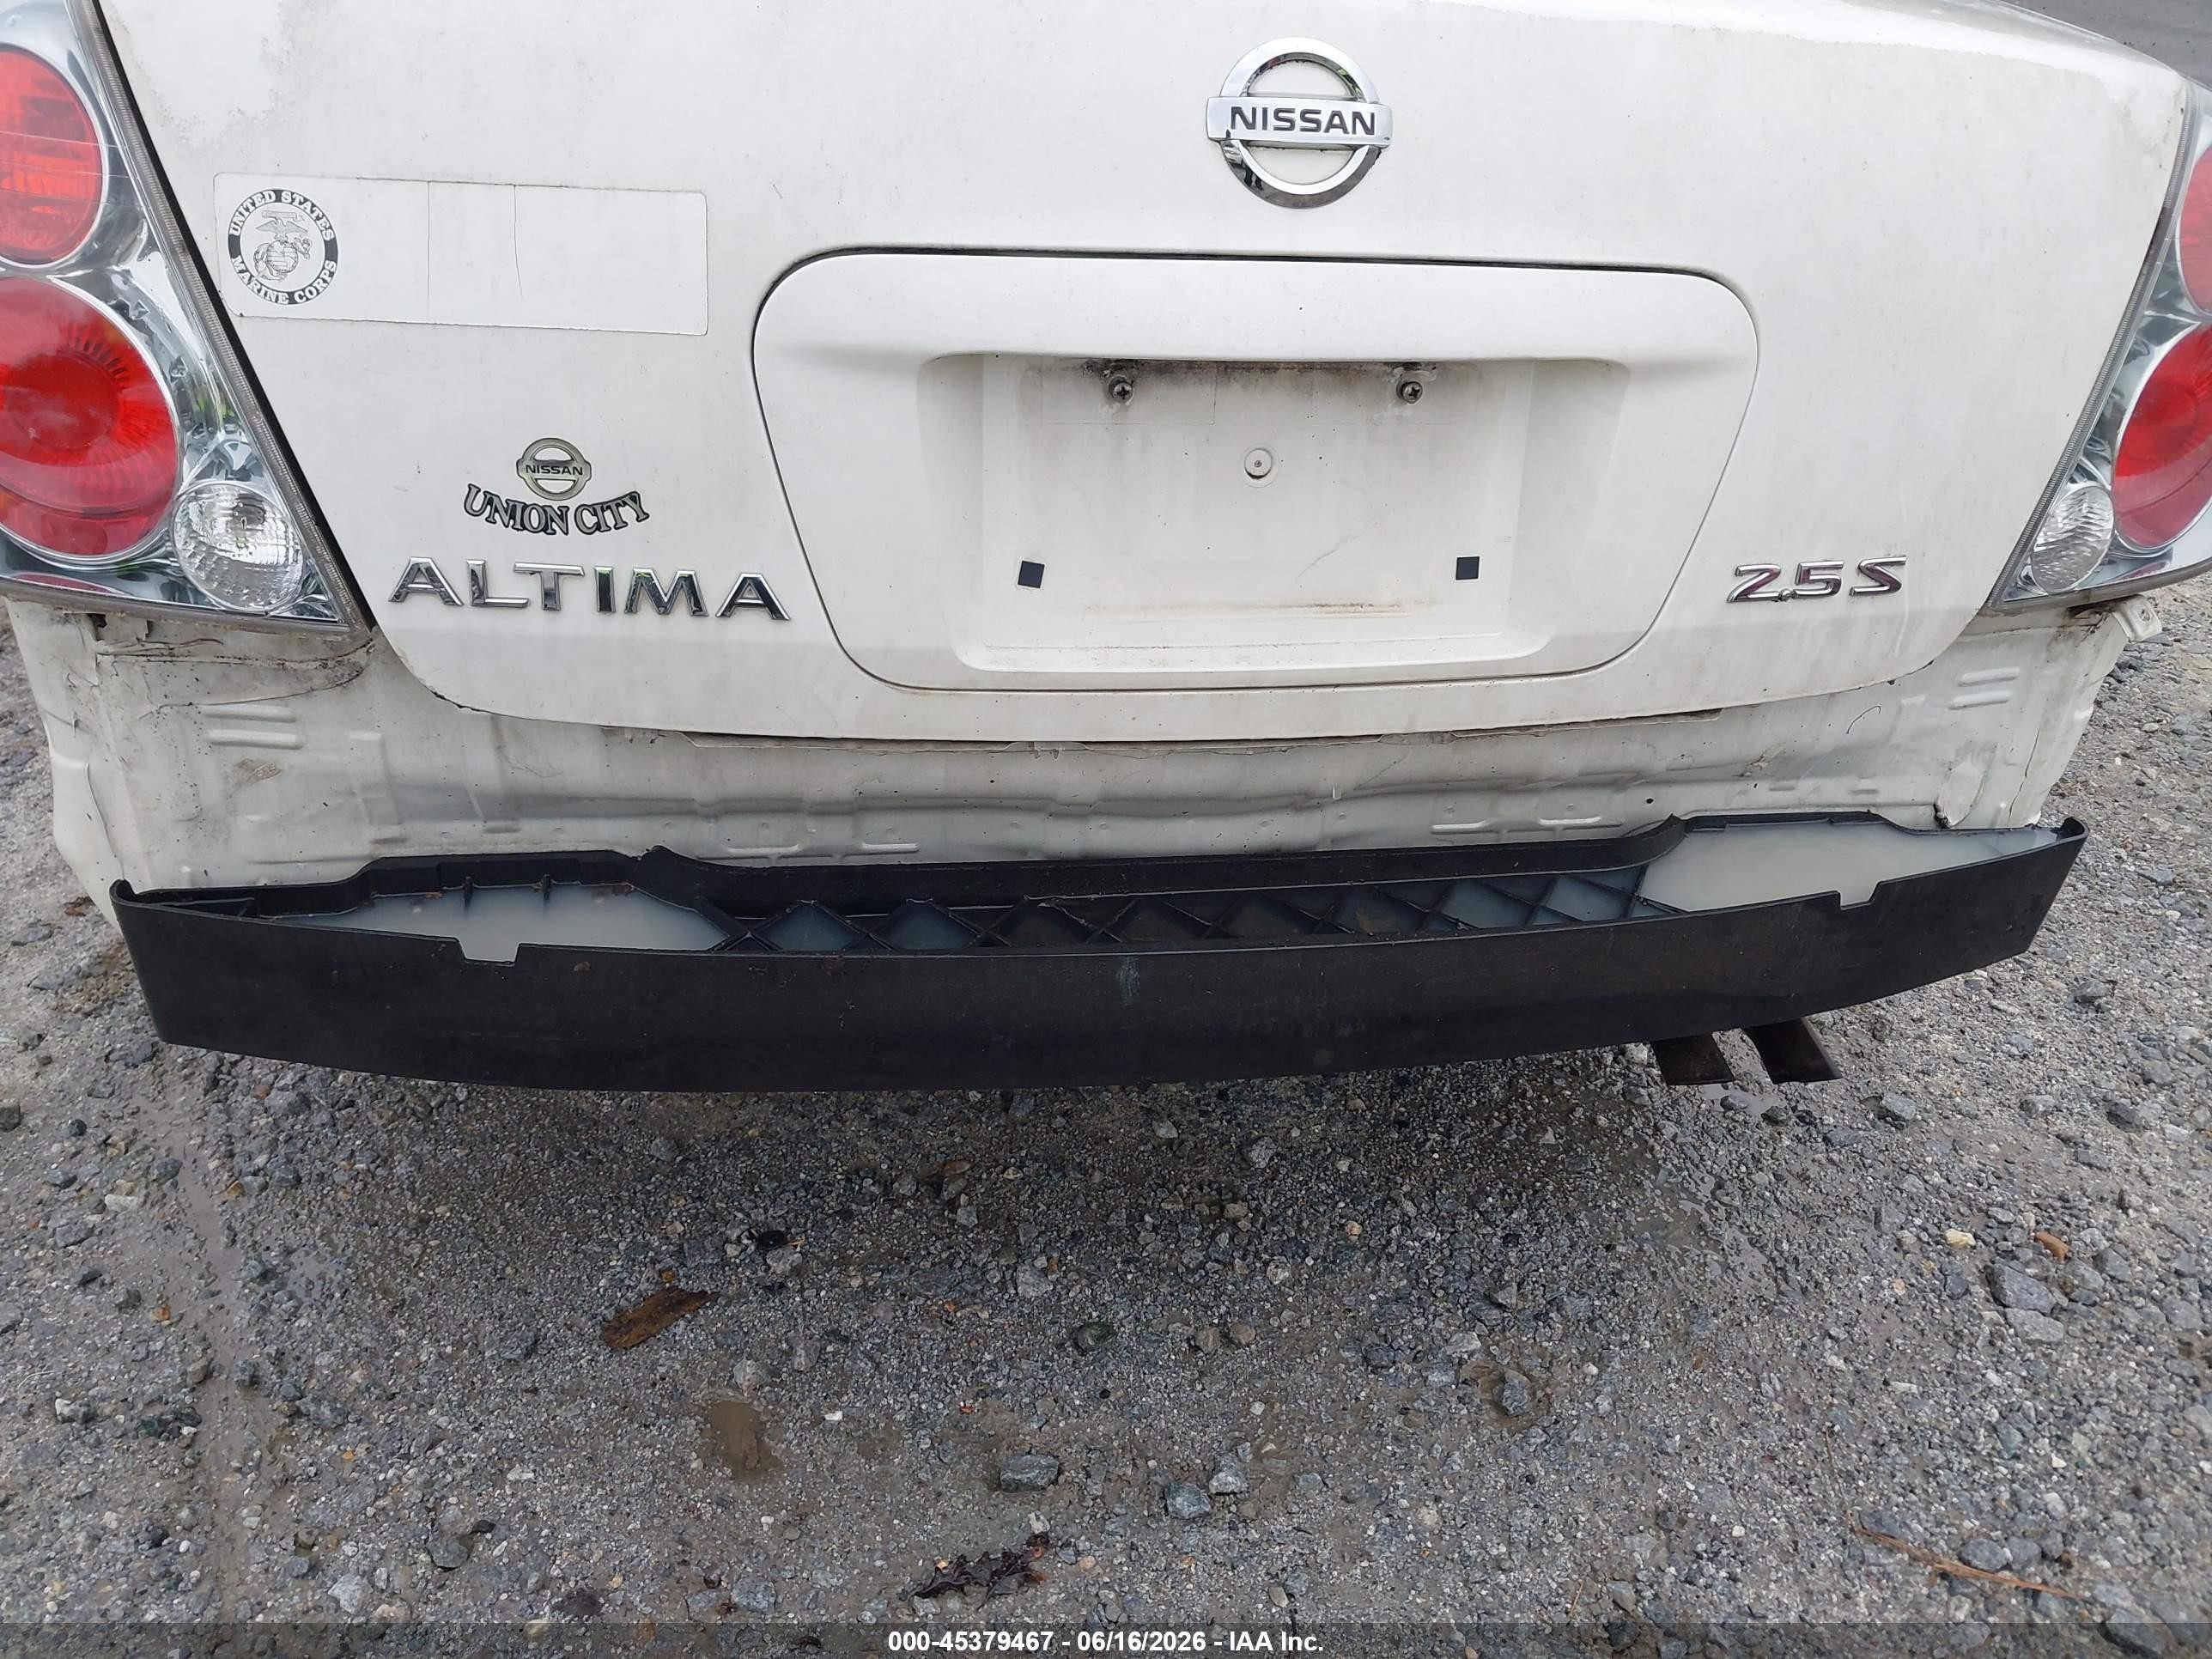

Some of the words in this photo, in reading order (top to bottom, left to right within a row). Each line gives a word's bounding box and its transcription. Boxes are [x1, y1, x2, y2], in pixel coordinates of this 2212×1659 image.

[1231, 106, 1375, 136] NISSAN
[229, 190, 276, 236] UNITED
[281, 191, 335, 240] STATES
[232, 255, 289, 304] MARINE
[294, 260, 337, 303] CORPS
[526, 465, 583, 476] NISSAN
[464, 483, 568, 536] UNION
[574, 490, 650, 535] CITY
[388, 556, 791, 621] ALTIMA
